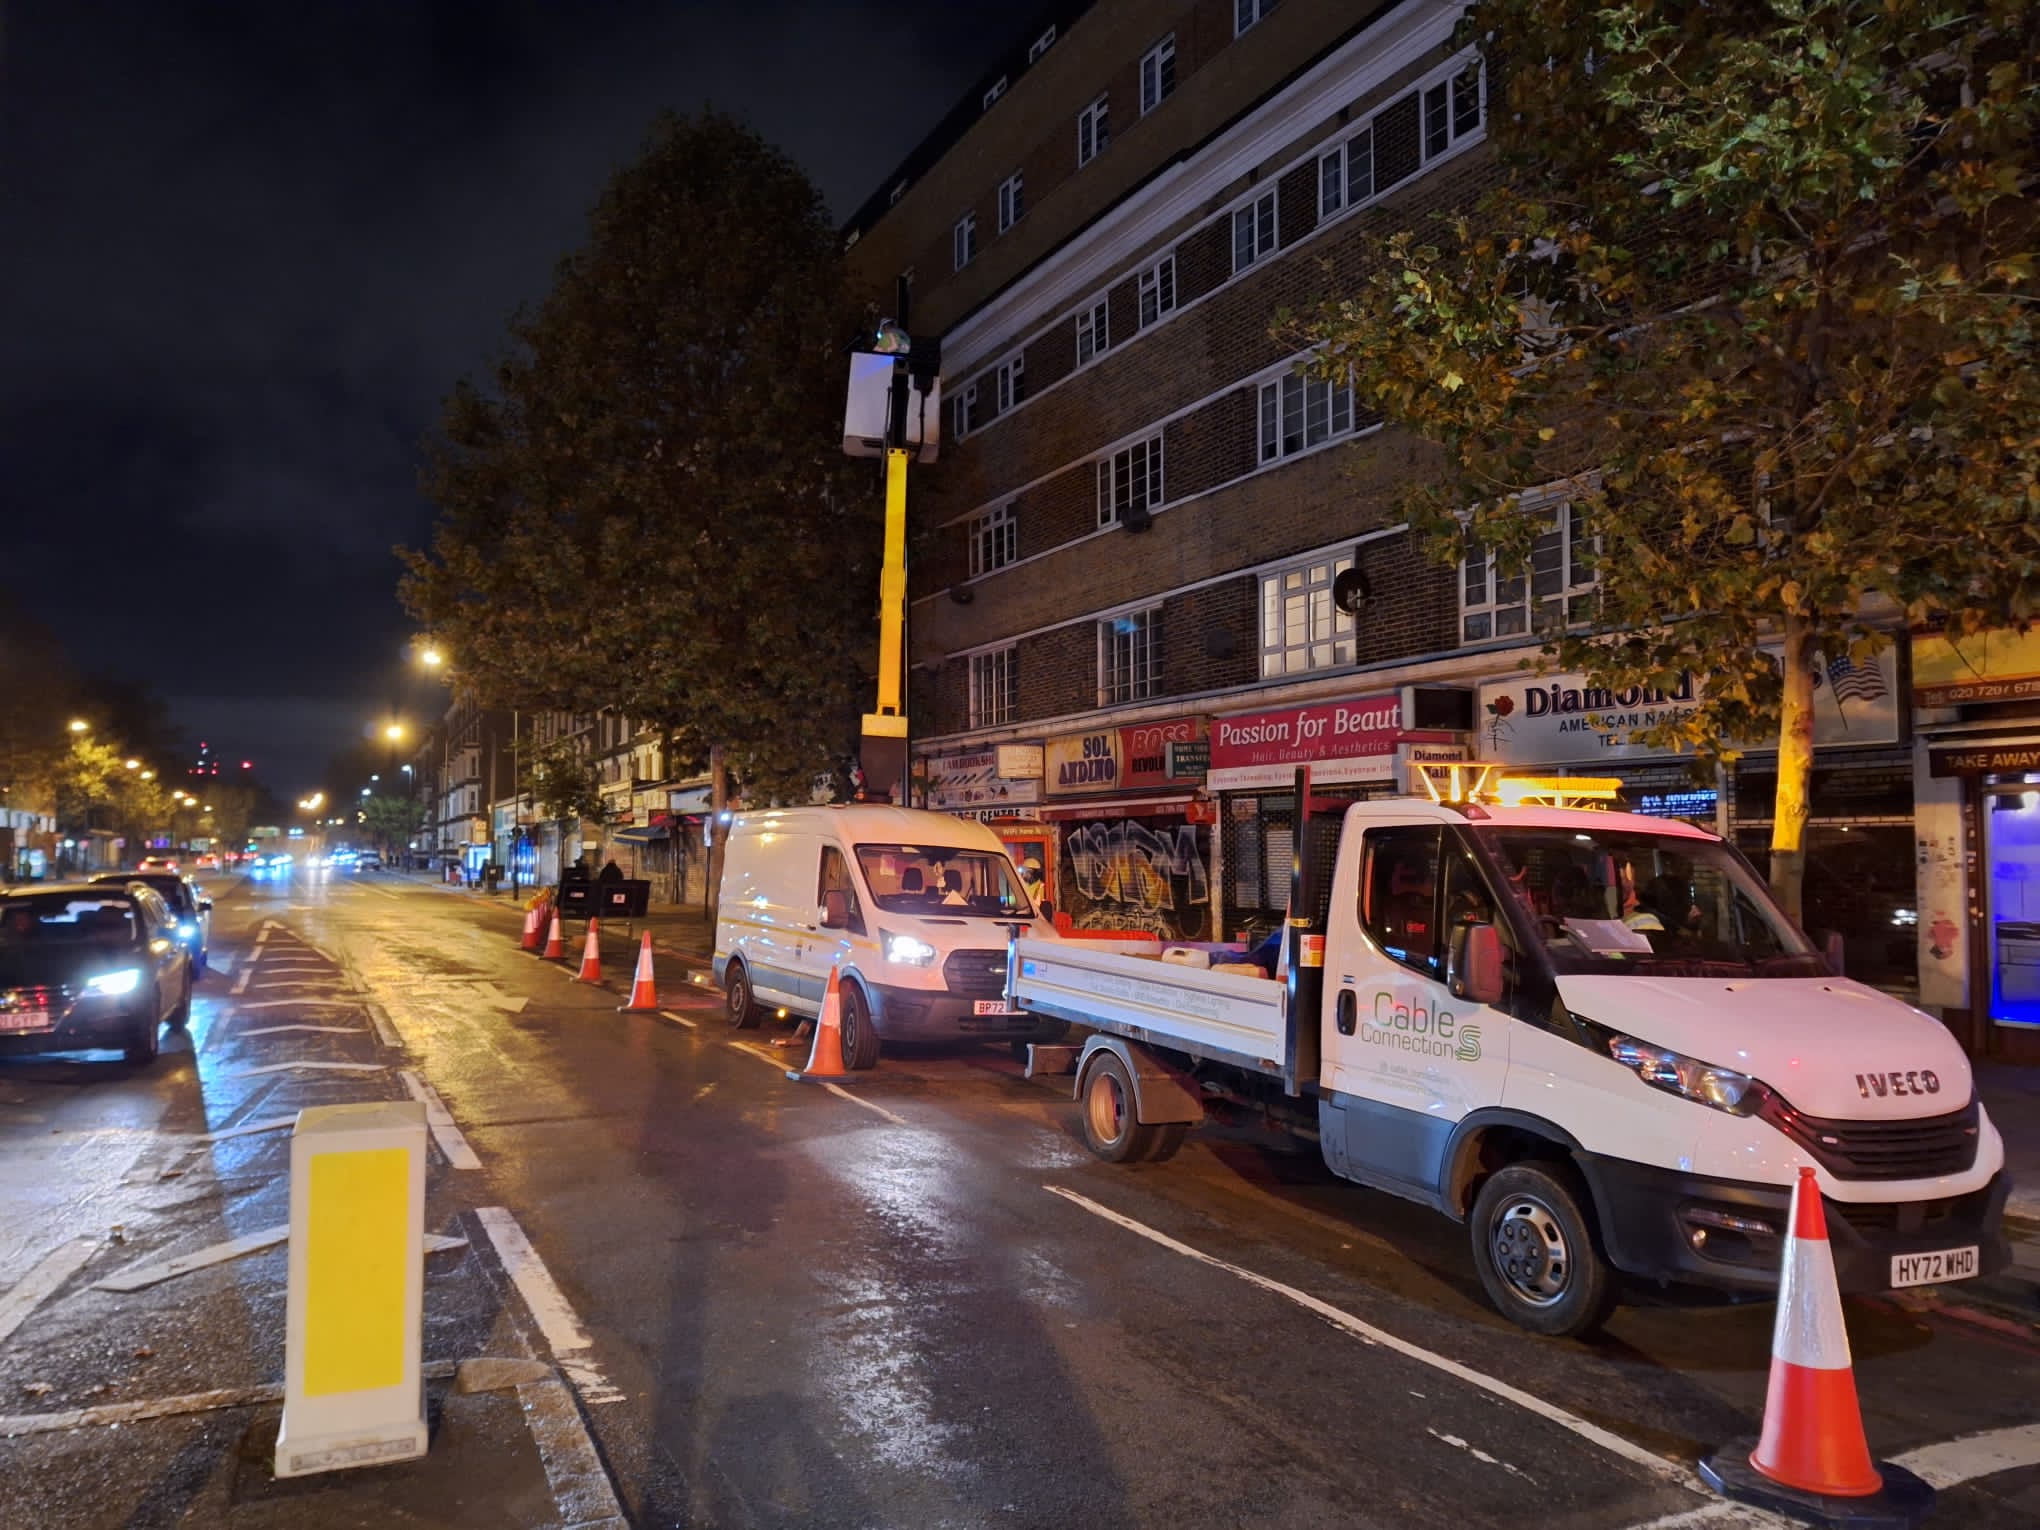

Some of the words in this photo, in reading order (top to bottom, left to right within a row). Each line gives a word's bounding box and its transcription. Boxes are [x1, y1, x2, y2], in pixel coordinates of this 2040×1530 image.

[1219, 719, 1289, 746] Passion
[1292, 712, 1327, 747] for
[1334, 704, 1403, 736] Beaut
[1559, 713, 1638, 733] AMEICAN
[1083, 735, 1111, 759] SOL
[1279, 748, 1314, 761] Beauty
[1332, 740, 1391, 755] Aesthetics
[1414, 750, 1462, 761] Diamond
[1945, 754, 1988, 768] TAKE
[1992, 751, 2040, 767] AWAY
[1058, 758, 1115, 785] ANDINO
[1375, 991, 1454, 1038] Cable
[1855, 1070, 1941, 1099] IVECO
[1898, 1255, 1942, 1283] HY72
[1945, 1250, 1974, 1276] WHD
